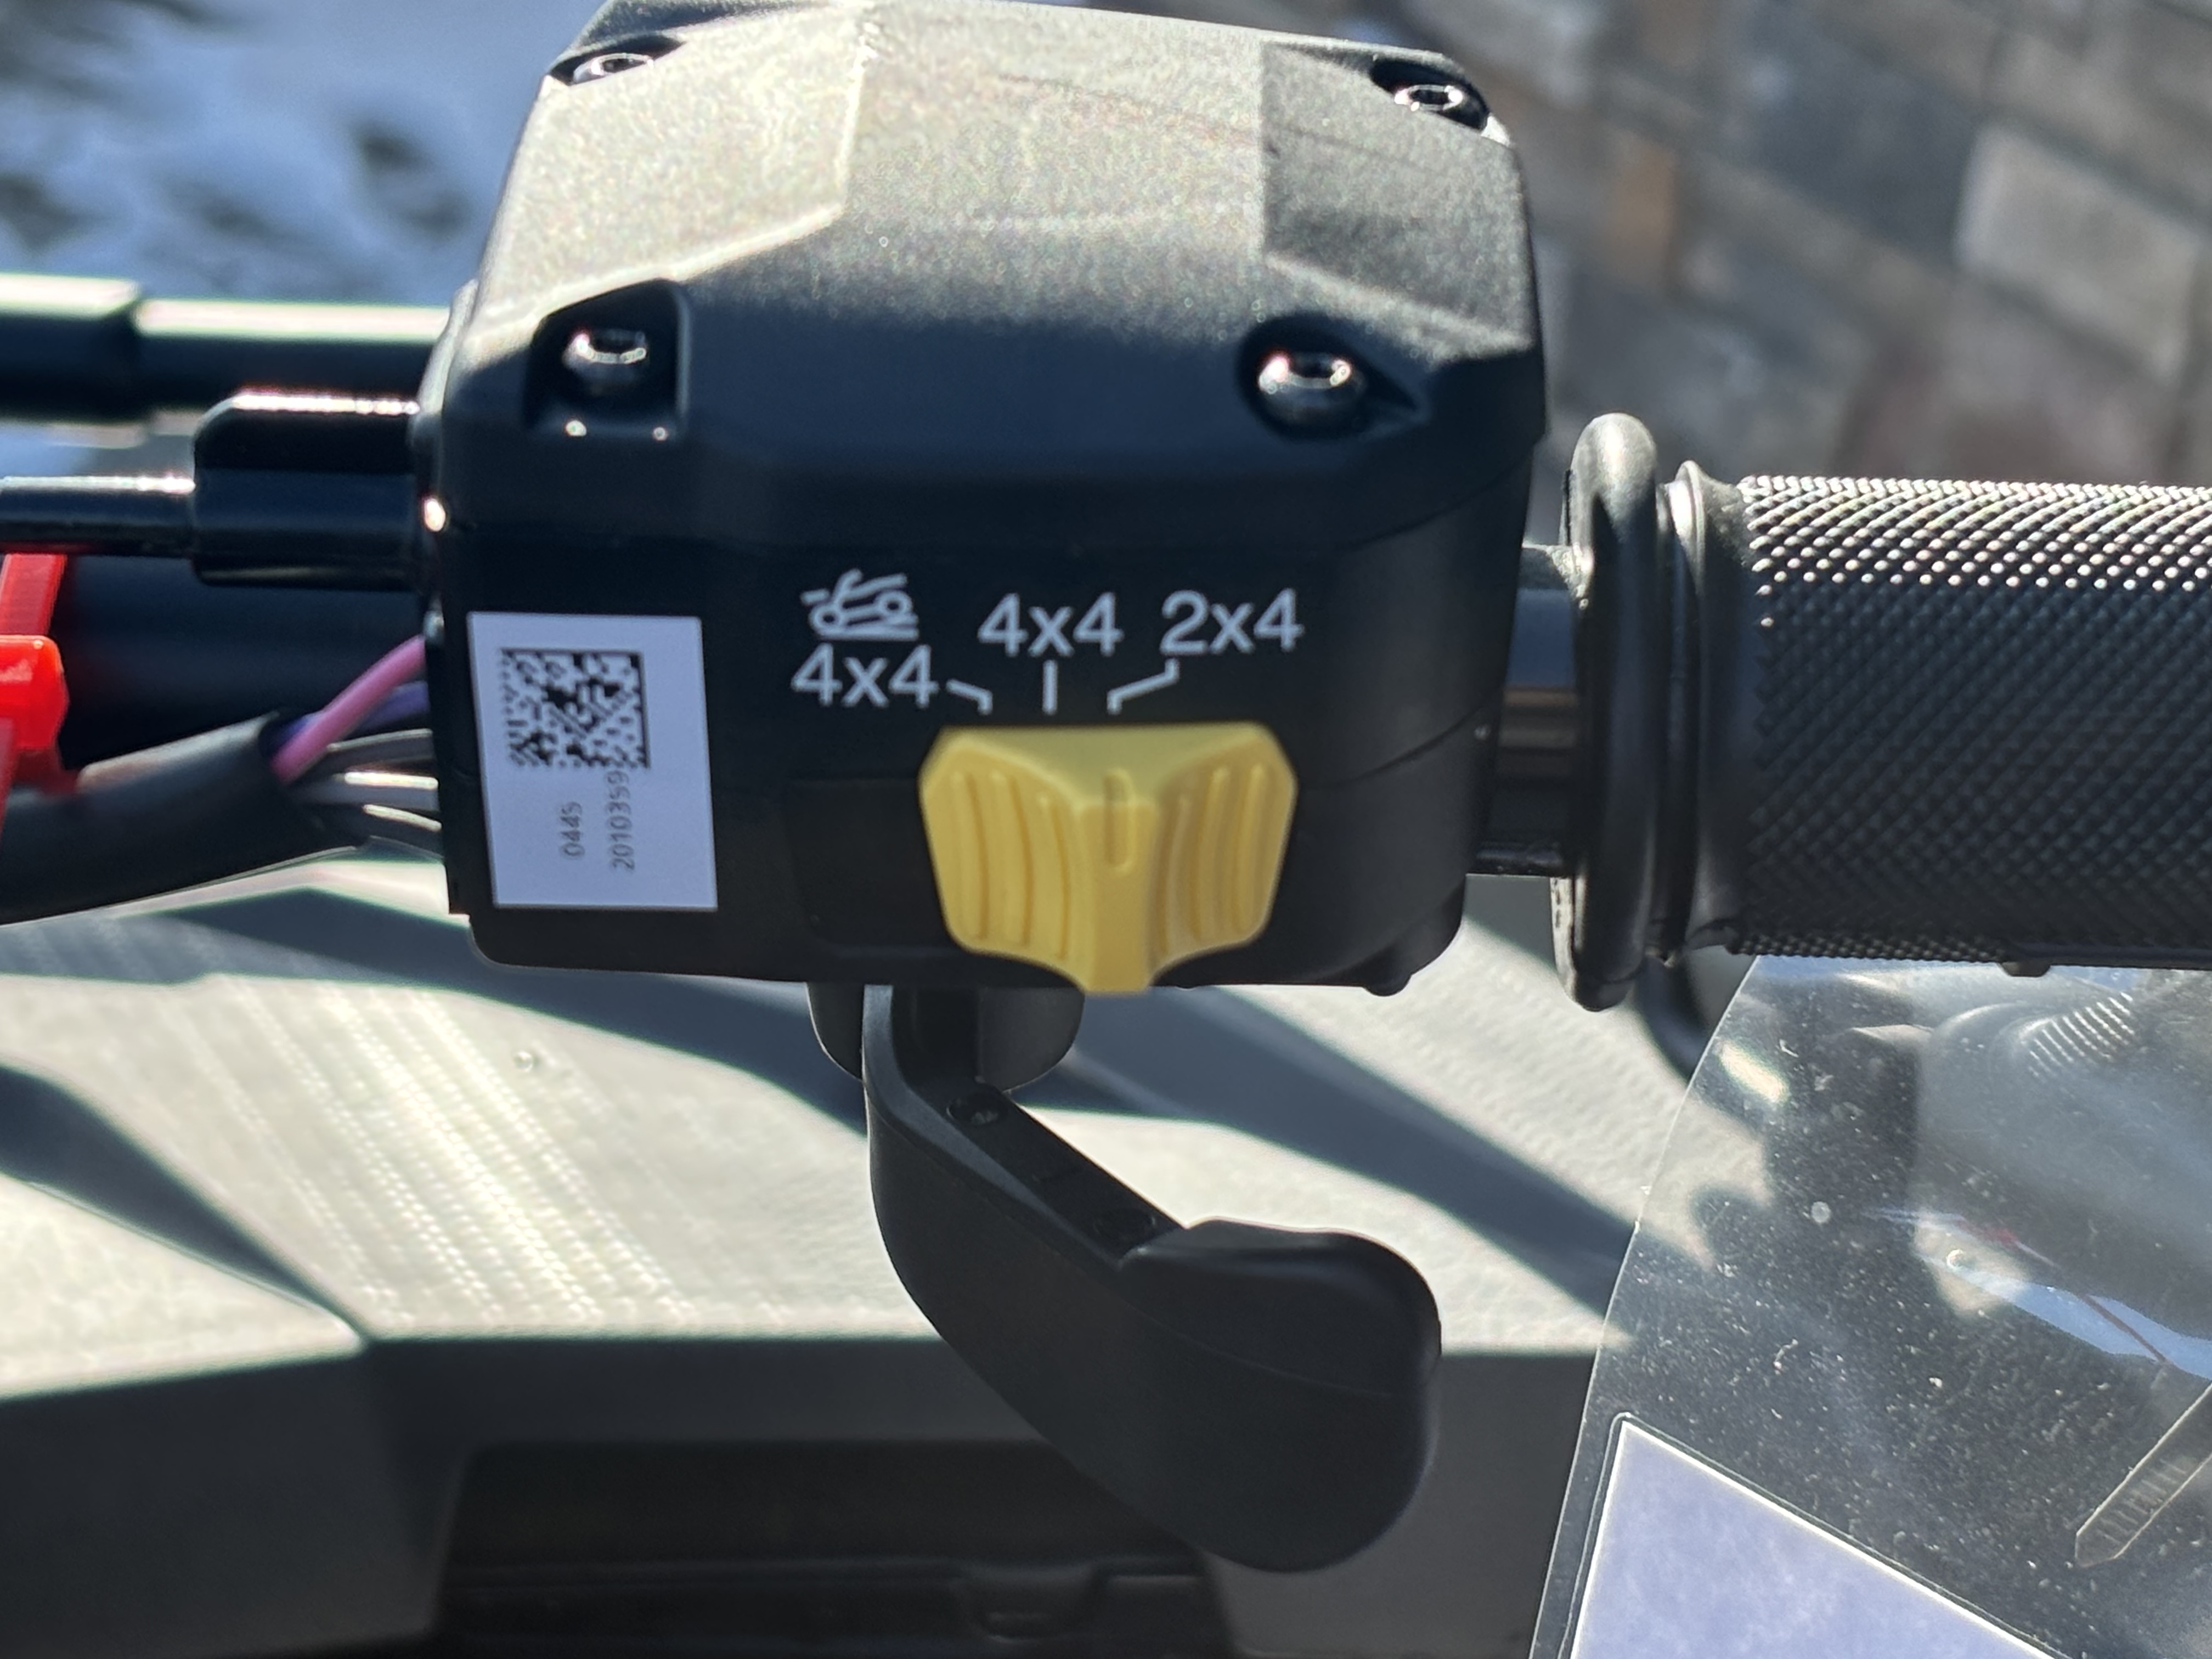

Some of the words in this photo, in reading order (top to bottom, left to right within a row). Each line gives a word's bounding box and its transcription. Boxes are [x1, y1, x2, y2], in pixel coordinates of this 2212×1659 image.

[978, 592, 1124, 657] 4x4
[1160, 589, 1304, 656] 2x4
[791, 643, 939, 707] 4x4
[560, 801, 585, 857] 0445
